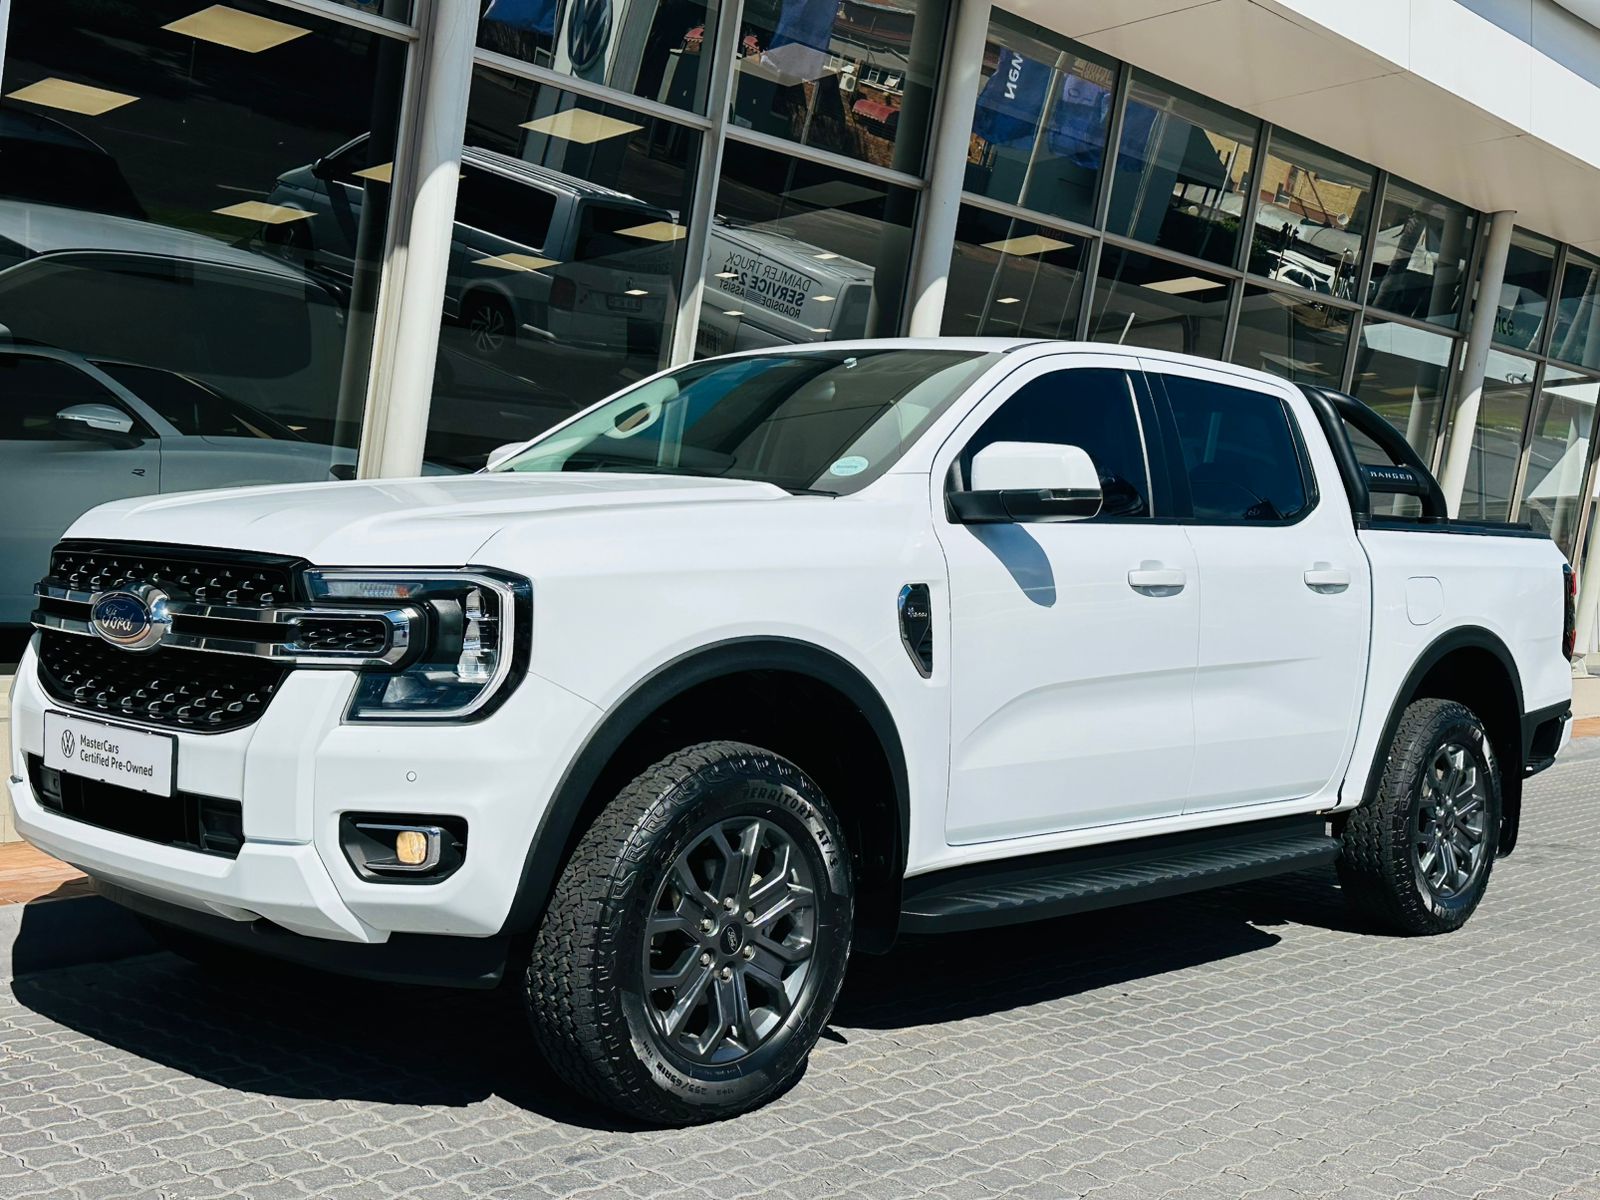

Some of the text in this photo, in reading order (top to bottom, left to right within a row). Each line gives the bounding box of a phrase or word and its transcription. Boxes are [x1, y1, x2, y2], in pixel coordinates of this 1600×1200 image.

[1370, 471, 1413, 480] RANGER
[101, 604, 134, 631] Ford
[80, 734, 120, 754] MasterCars
[80, 749, 153, 777] Certified Pre-Owned
